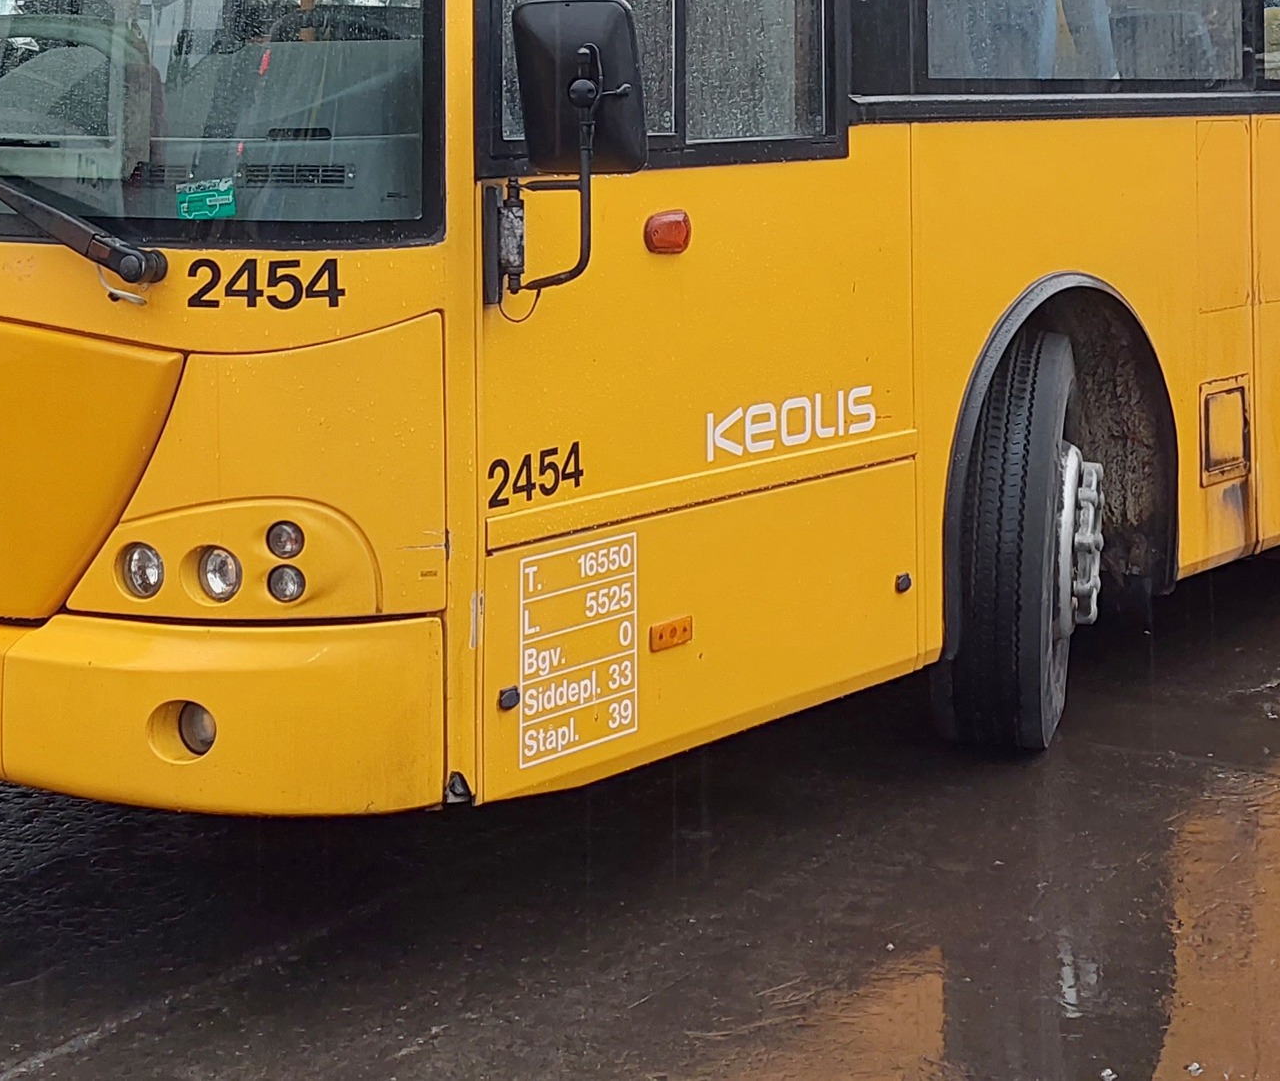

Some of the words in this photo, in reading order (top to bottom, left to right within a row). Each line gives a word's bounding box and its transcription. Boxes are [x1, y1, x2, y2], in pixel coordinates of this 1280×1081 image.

[187, 258, 346, 310] 2454
[487, 441, 584, 509] 2454
[524, 566, 542, 592] T.
[578, 543, 632, 578] 16550
[524, 610, 540, 635] L.
[585, 582, 632, 617] 5525
[524, 647, 566, 676] Bgv.
[619, 621, 632, 646] 0
[524, 670, 601, 716] Siddepl.
[608, 660, 632, 690] 33
[524, 717, 579, 757] Ståpl.
[608, 699, 632, 728] 39
